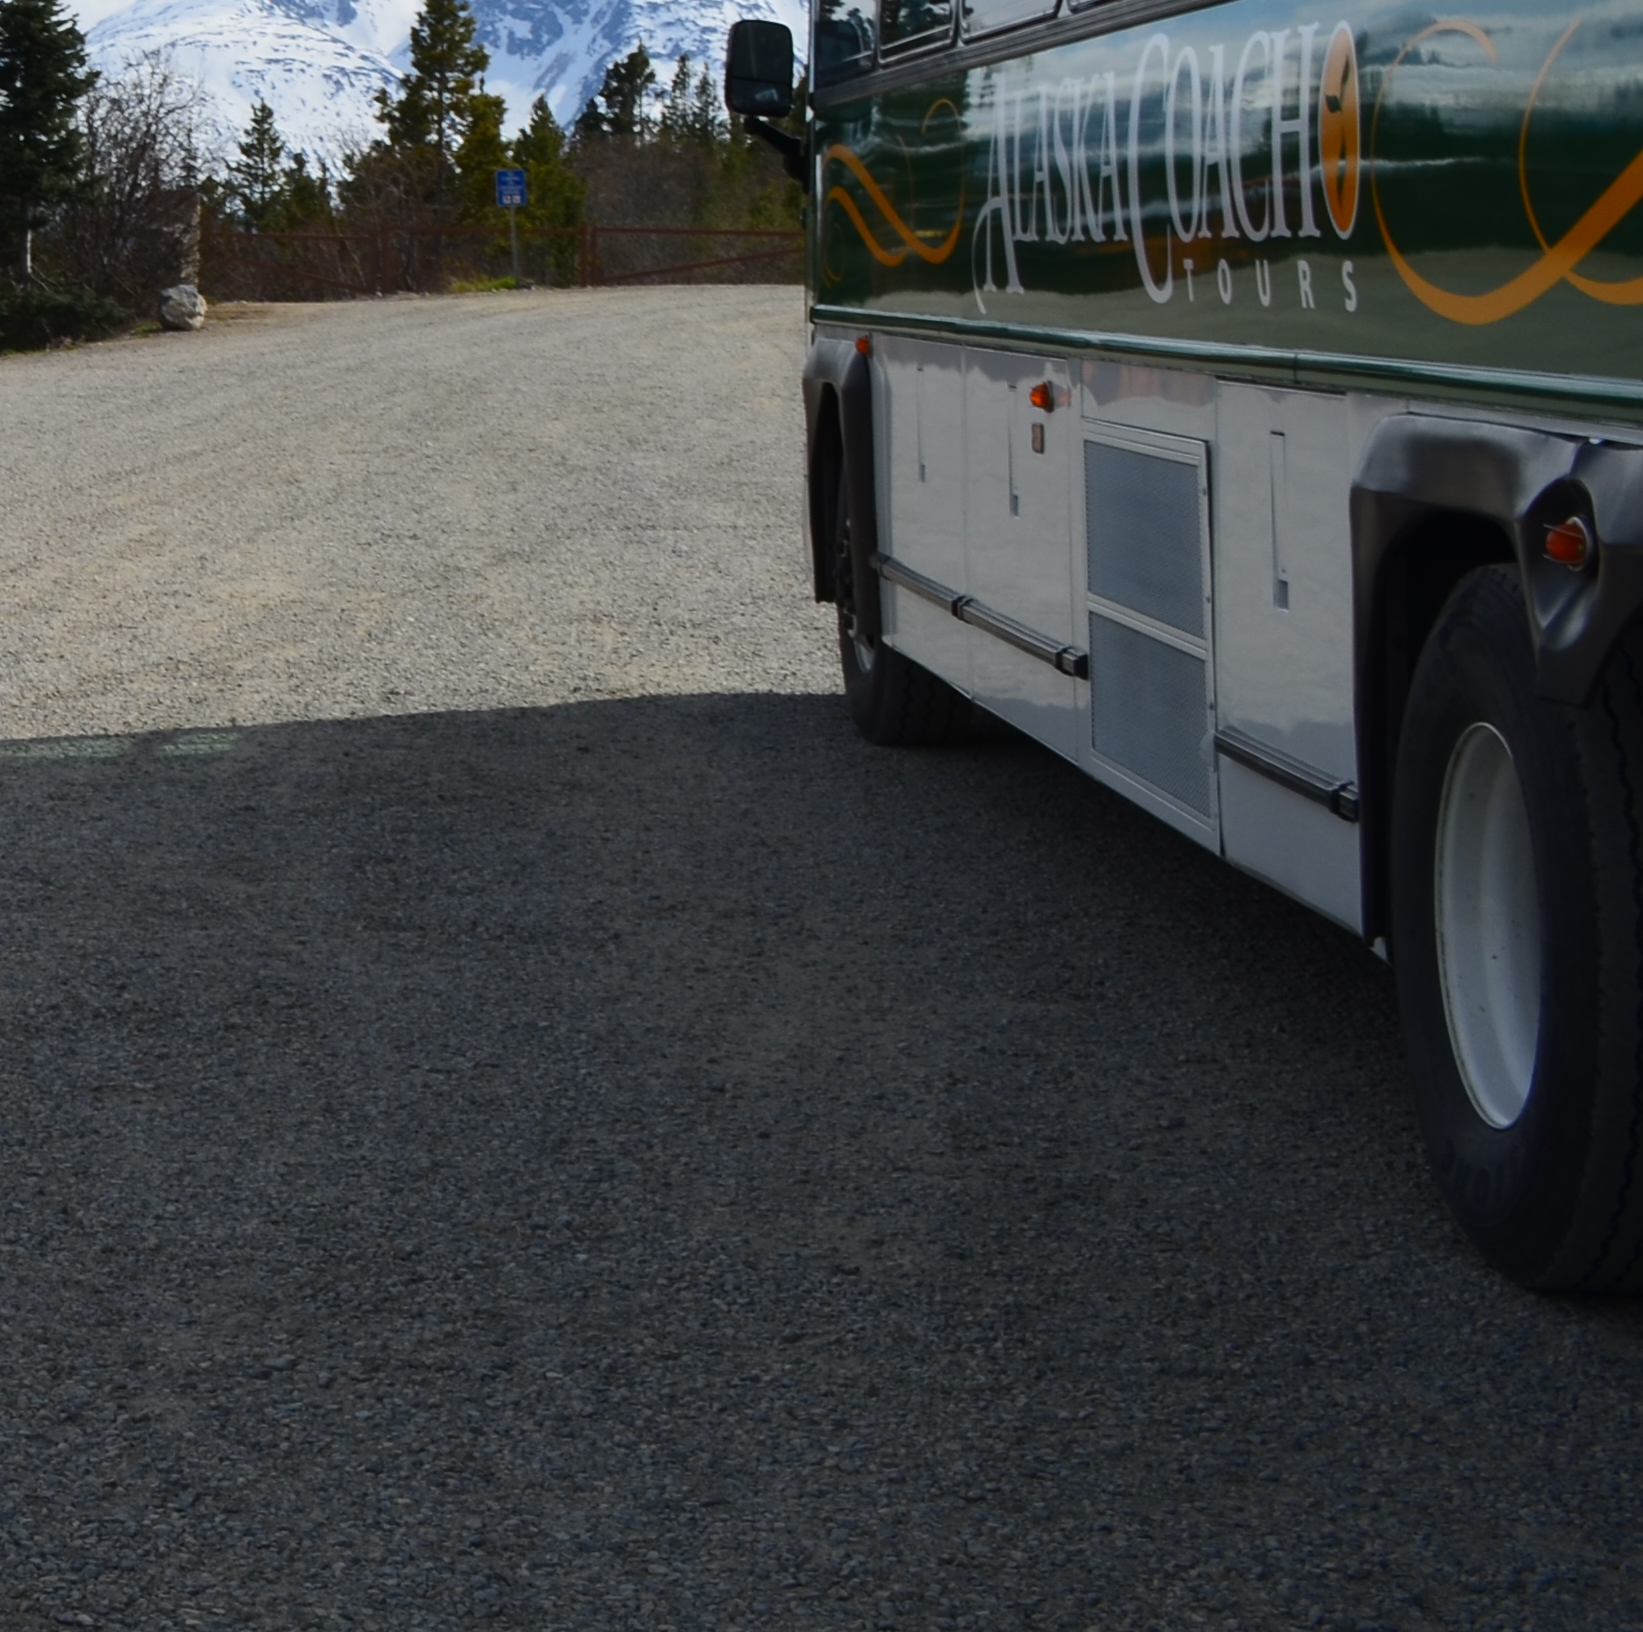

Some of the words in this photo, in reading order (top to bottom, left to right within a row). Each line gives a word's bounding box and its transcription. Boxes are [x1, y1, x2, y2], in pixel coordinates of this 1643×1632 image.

[971, 71, 1129, 315] ALASKA
[1127, 22, 1321, 305] COACH
[1182, 258, 1358, 313] TOURS
